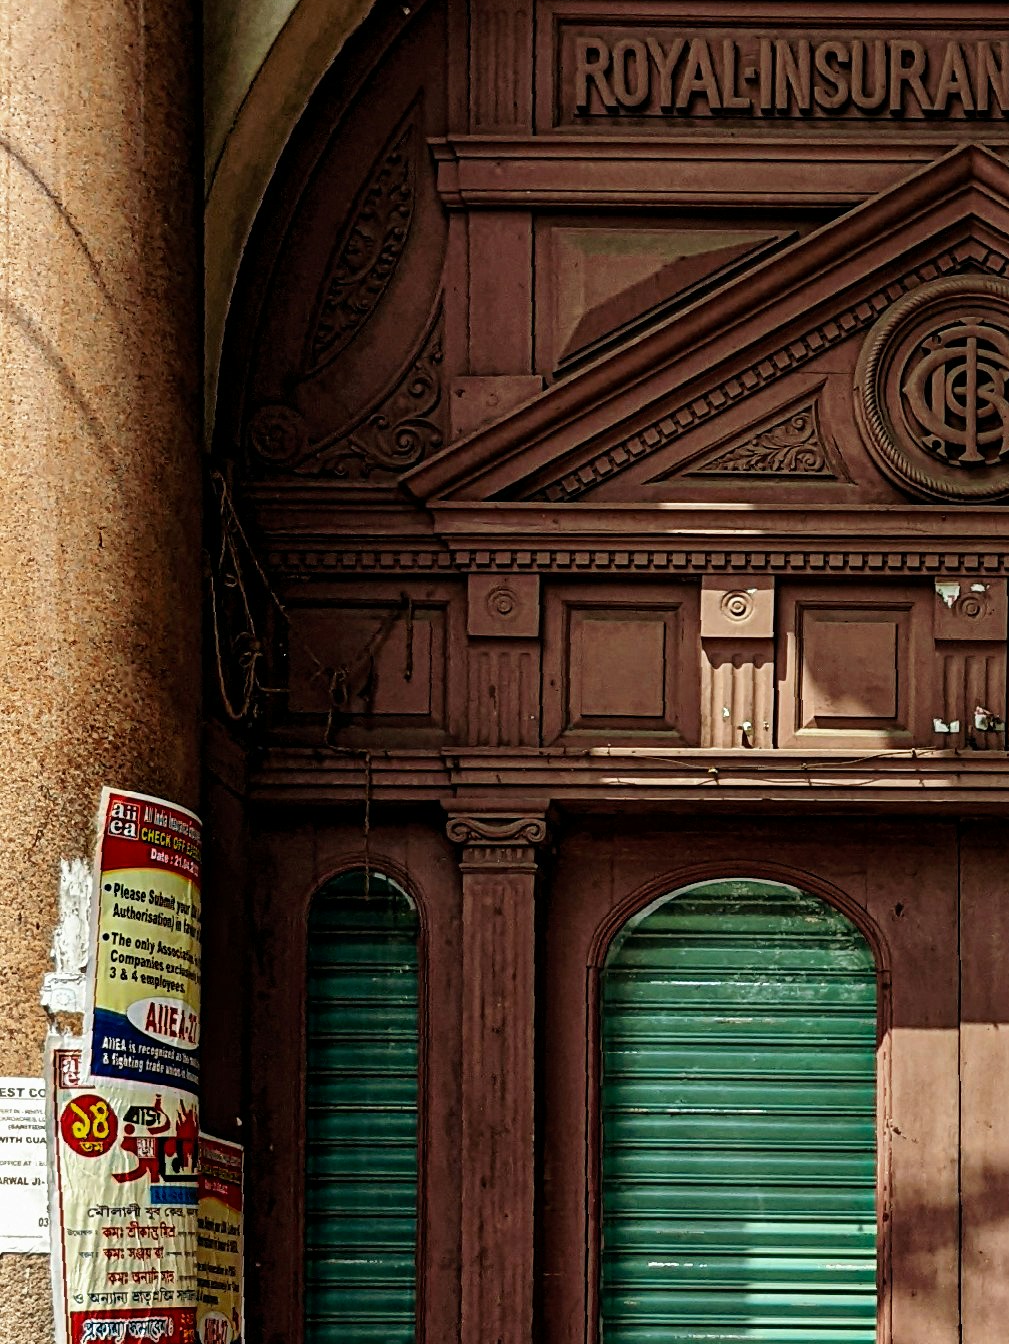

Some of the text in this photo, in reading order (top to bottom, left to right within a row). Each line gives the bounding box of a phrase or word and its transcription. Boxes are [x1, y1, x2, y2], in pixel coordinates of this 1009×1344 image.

[576, 37, 751, 113] ROYAL
[142, 828, 171, 847] CHECK
[151, 848, 169, 863] Date
[114, 883, 146, 903] Please
[149, 889, 175, 911] Submit
[111, 932, 132, 947] The
[135, 938, 155, 955] only
[111, 950, 164, 971] Companies
[110, 967, 117, 979] 3
[120, 968, 128, 981] &
[131, 970, 138, 982] 4
[102, 1036, 127, 1051] AIIEA
[128, 1040, 136, 1053] is
[111, 1053, 144, 1073] fighting
[146, 1059, 164, 1073] trade
